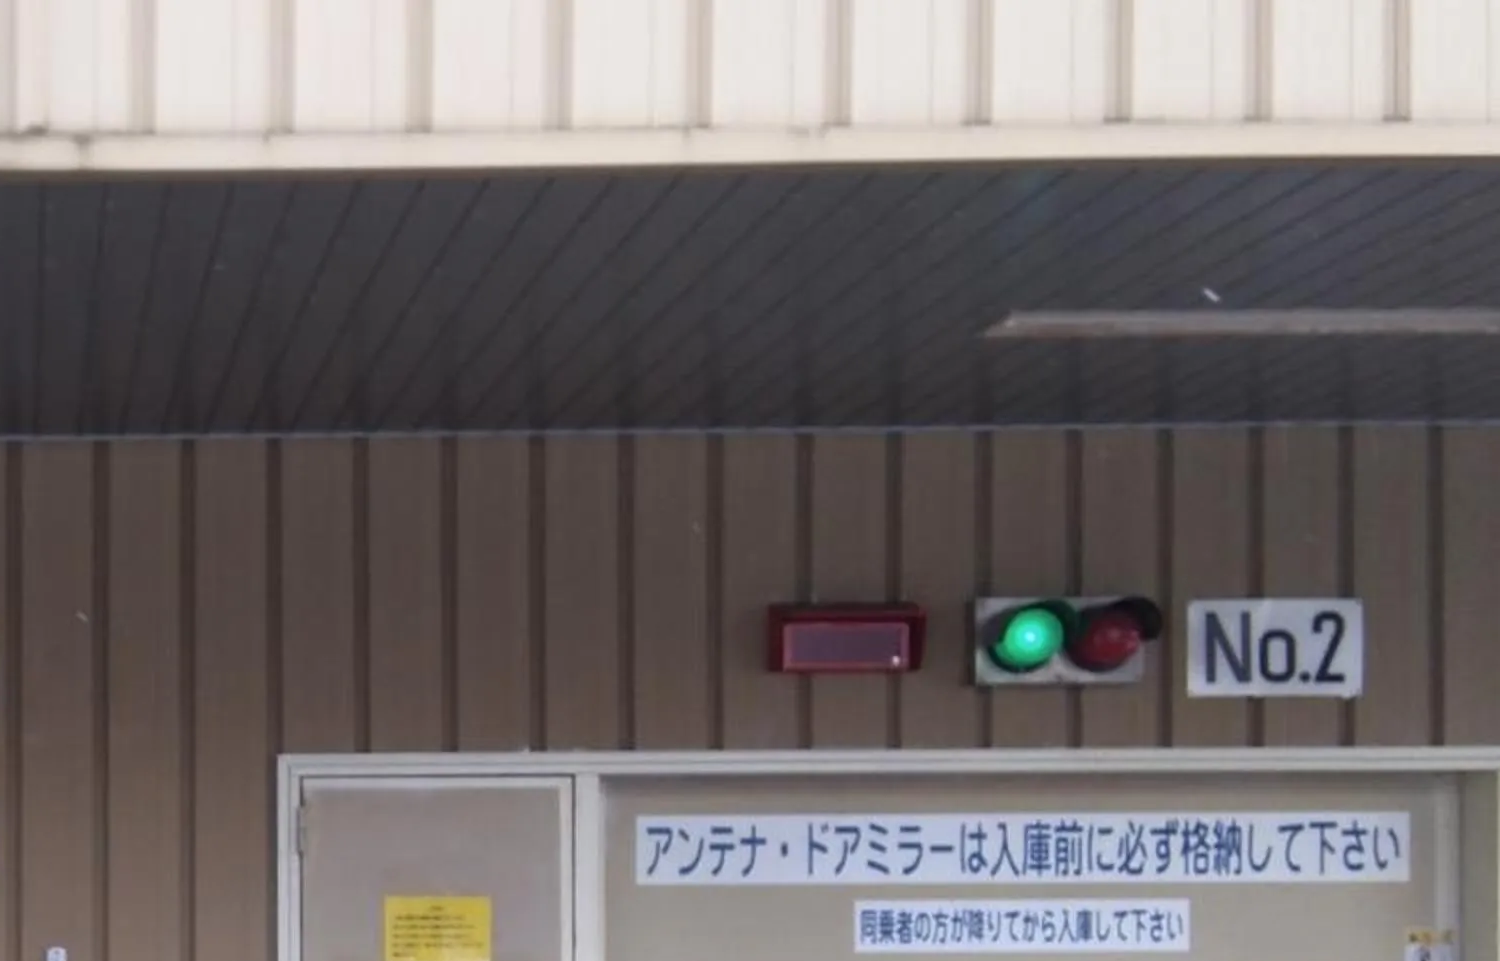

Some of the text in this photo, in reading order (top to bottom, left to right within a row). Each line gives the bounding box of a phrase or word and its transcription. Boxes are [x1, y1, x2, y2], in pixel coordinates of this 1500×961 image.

[1205, 611, 1347, 684] No.2
[646, 819, 1401, 877] アンテナ・ドアミラーは入庫前に必ず格納して下さい
[860, 909, 1184, 945] 同乗者の方が降りてから入庫して下さい
